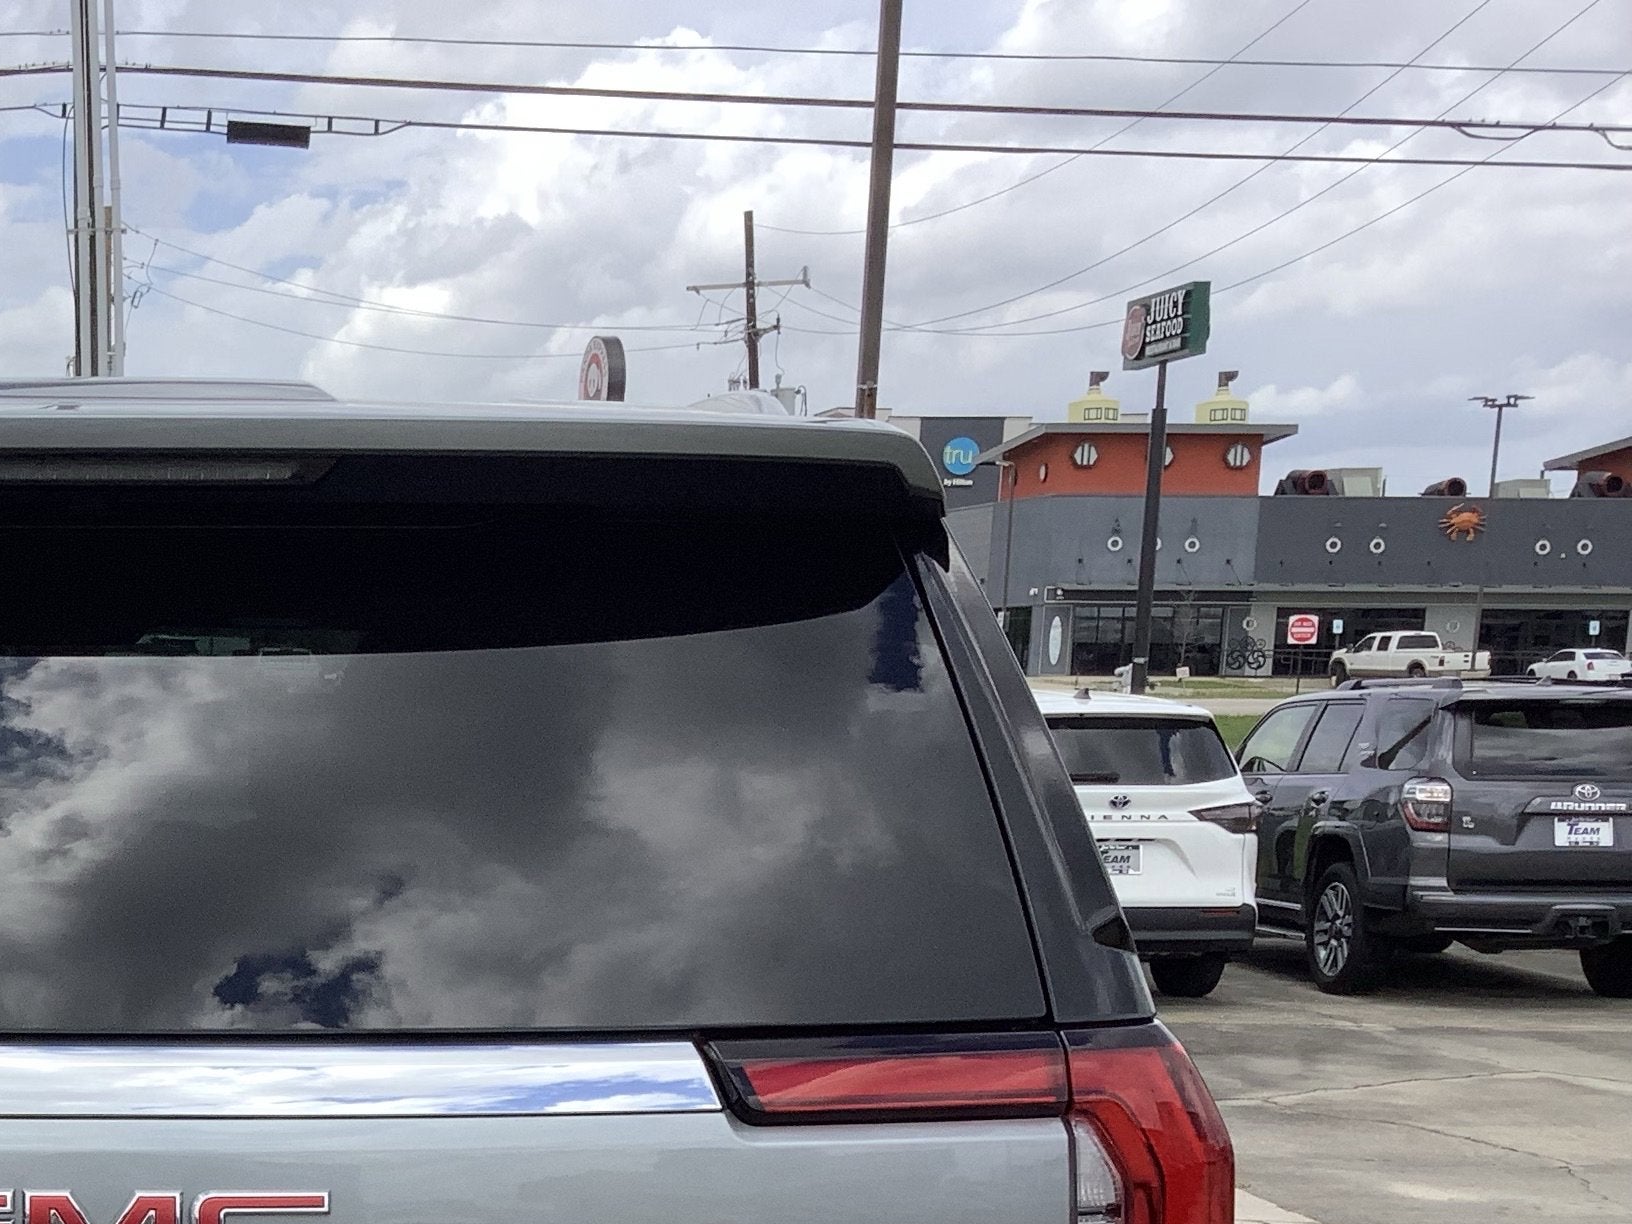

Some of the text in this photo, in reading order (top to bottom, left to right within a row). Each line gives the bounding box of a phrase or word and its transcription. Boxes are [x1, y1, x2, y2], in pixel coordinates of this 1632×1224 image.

[1146, 289, 1187, 325] JUICY
[1145, 317, 1184, 343] SEAFOOD
[943, 445, 973, 465] tru
[1567, 822, 1601, 836] TEAM
[1101, 851, 1131, 864] EAM
